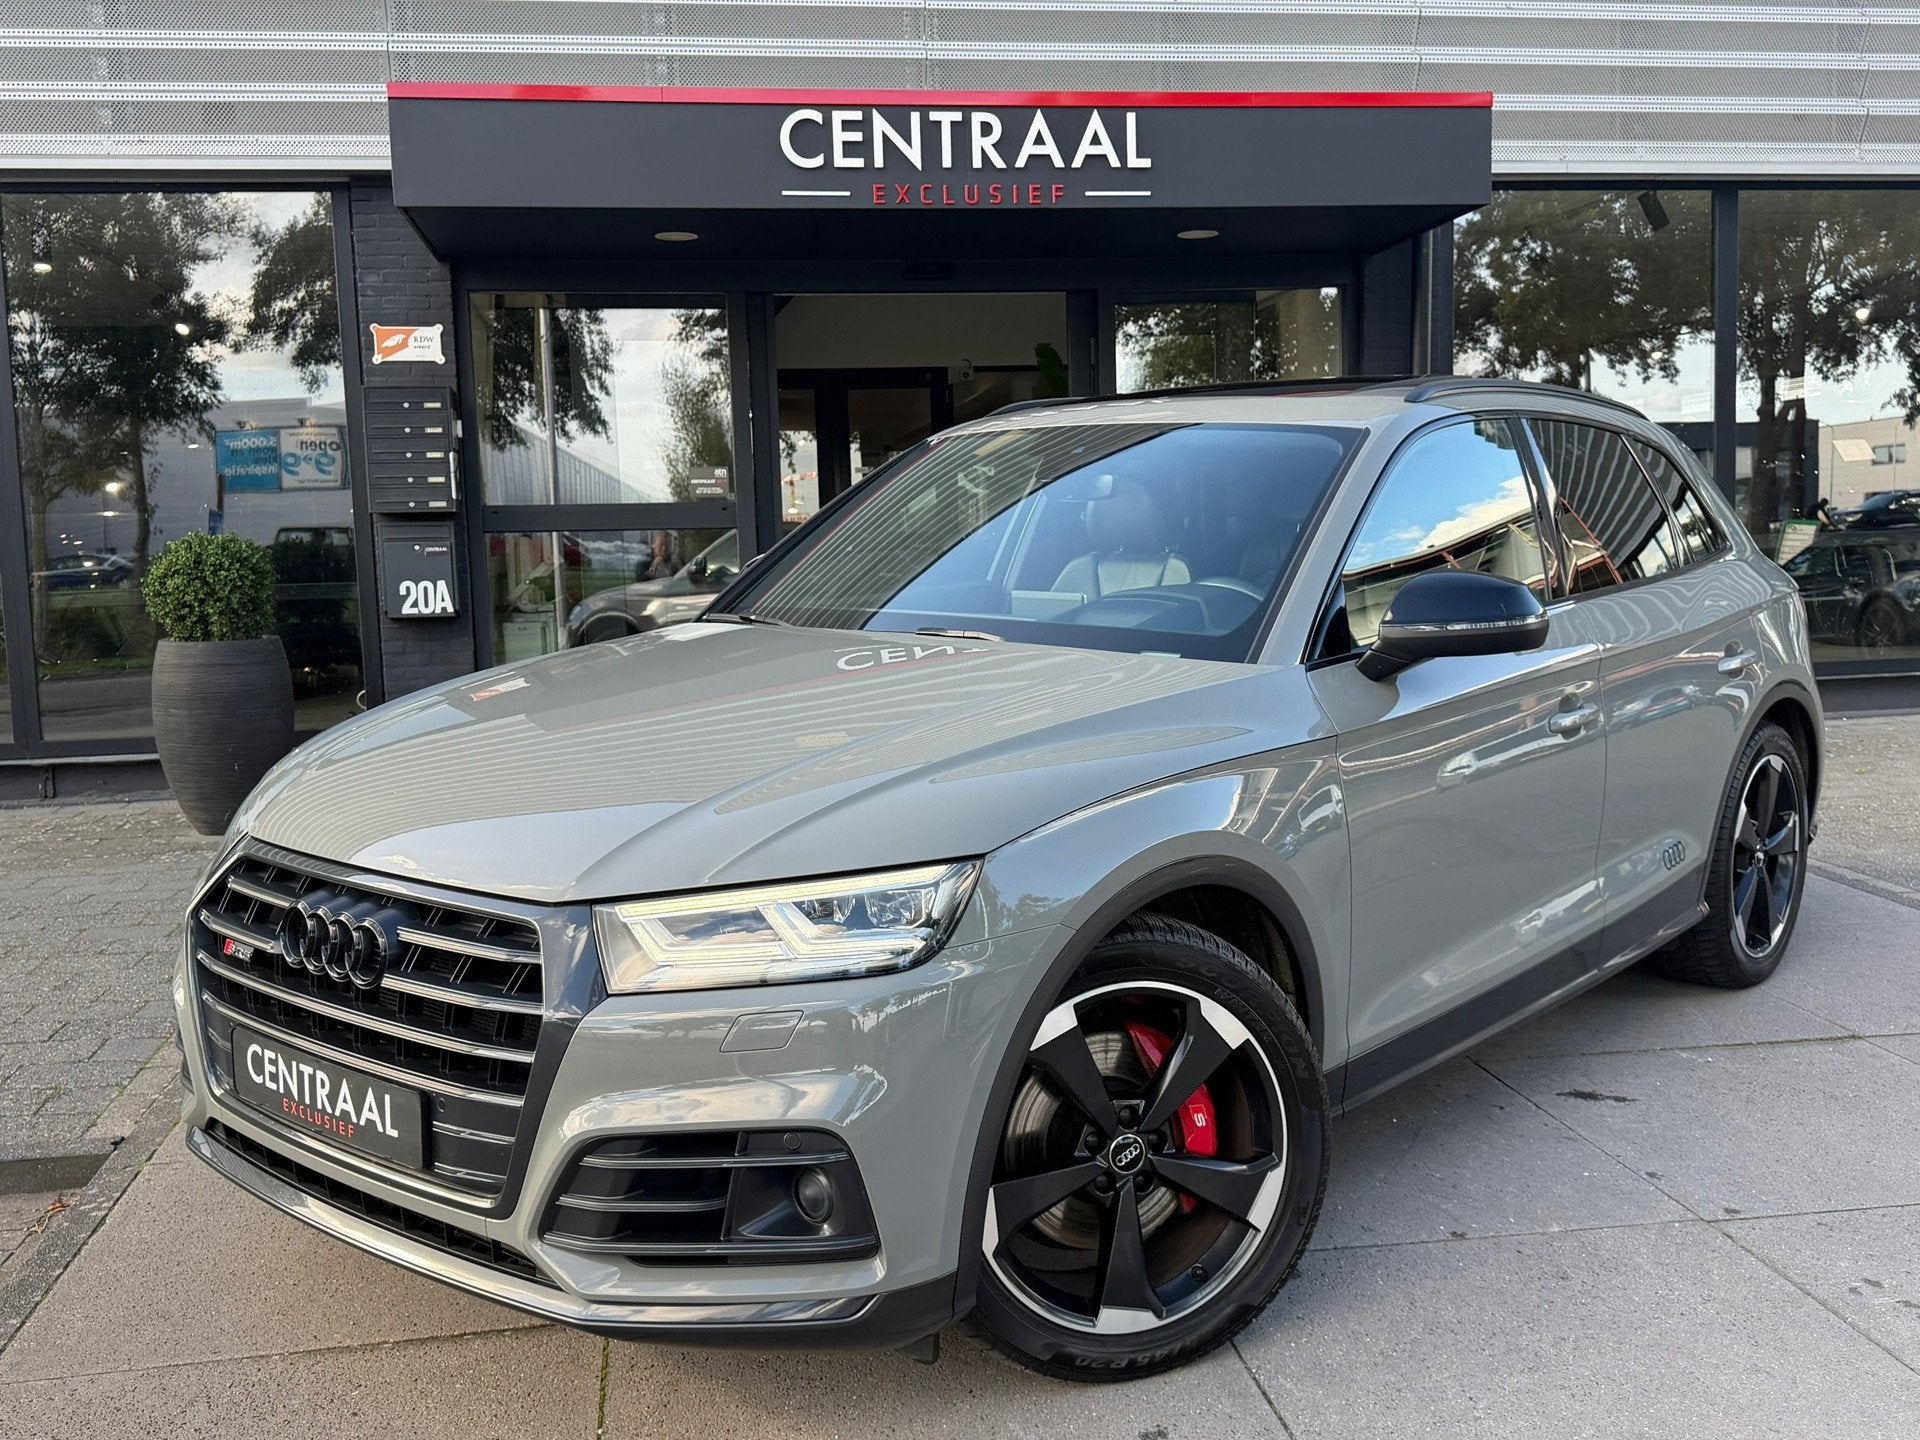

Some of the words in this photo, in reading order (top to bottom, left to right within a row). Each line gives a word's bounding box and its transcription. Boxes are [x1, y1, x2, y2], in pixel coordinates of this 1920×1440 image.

[779, 108, 1152, 171] CENTRAAL
[872, 183, 1066, 205] EXCLUSIEF
[399, 579, 455, 615] 20A
[246, 1043, 399, 1138] CENTRAAL
[282, 1097, 355, 1138] EXCLUSIEF
[1193, 1112, 1206, 1127] S
